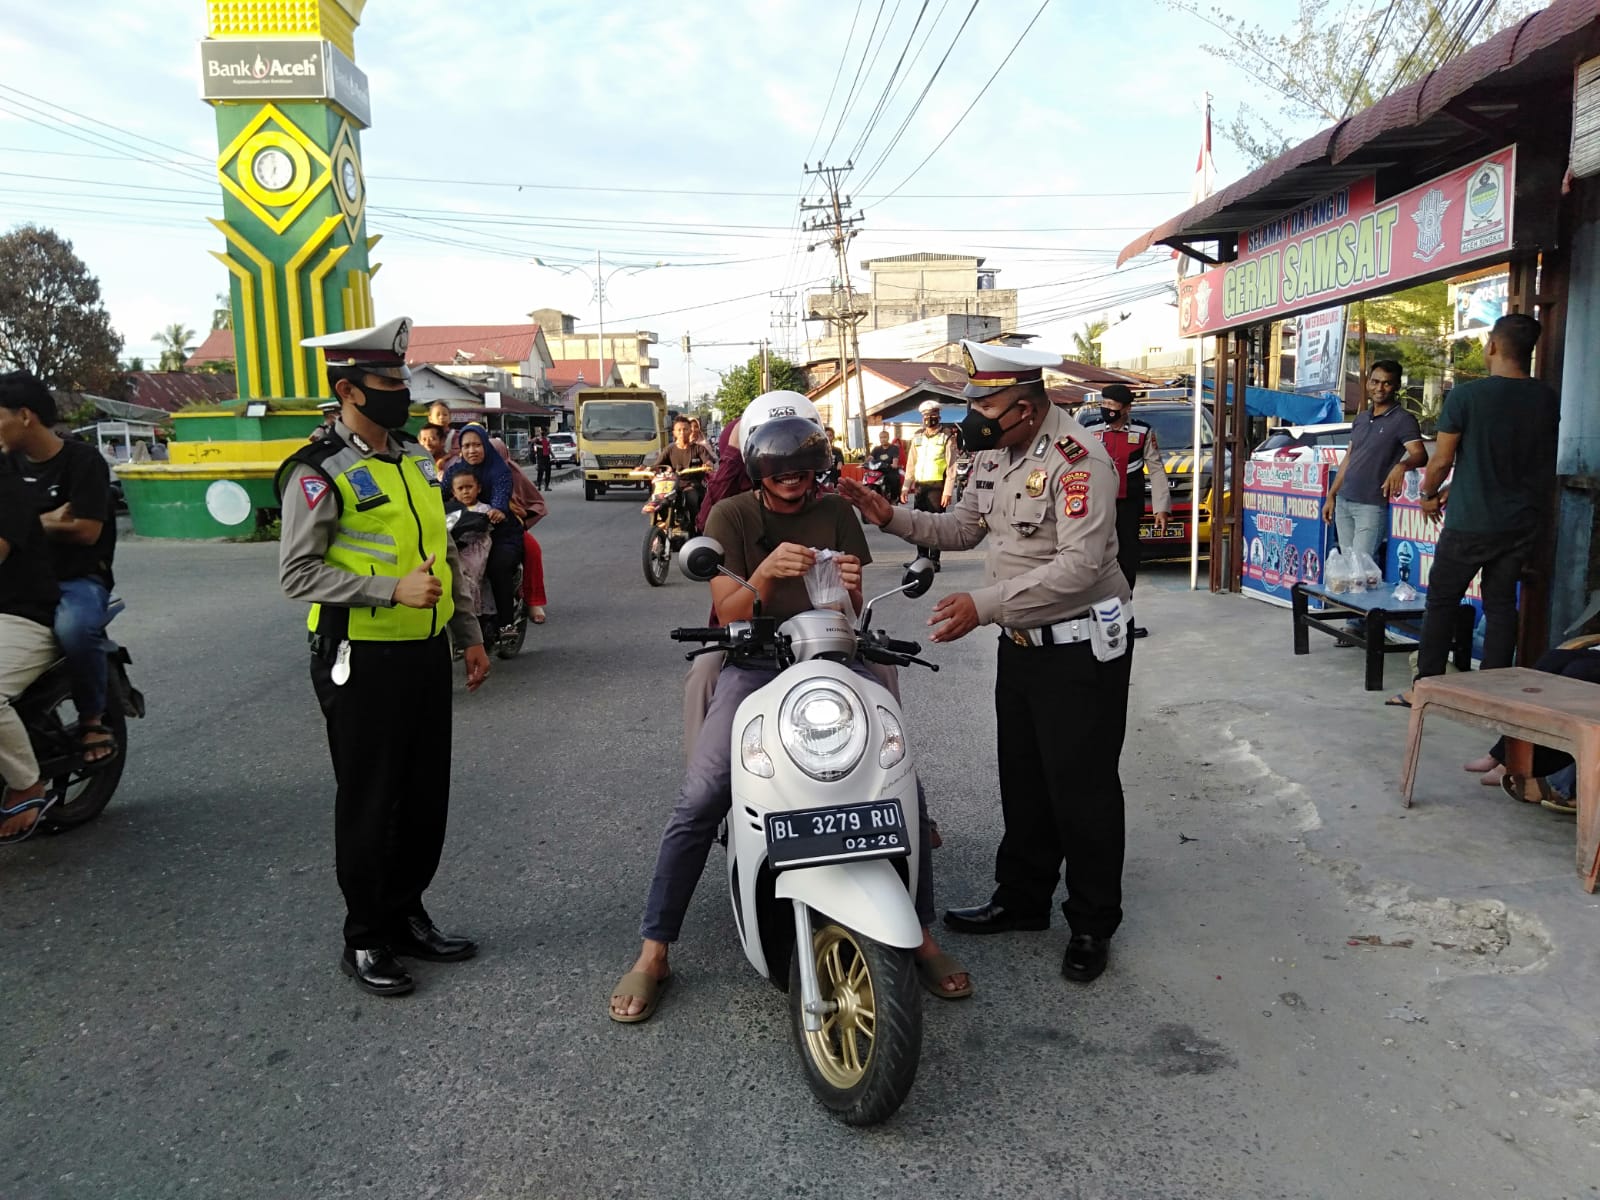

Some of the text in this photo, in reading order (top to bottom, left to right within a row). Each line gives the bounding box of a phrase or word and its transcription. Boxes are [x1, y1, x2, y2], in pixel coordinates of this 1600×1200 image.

[208, 59, 316, 77] Bank Aceh
[1248, 187, 1349, 253] SELAMAT DATANG DI
[1462, 233, 1503, 250] ACEH SINGKIL
[1224, 206, 1398, 320] GERAI SAMSAT
[1476, 286, 1496, 301] POS
[1287, 496, 1319, 519] PROKES
[1257, 515, 1277, 532] INGAT
[774, 808, 896, 839] BL 3279 RU
